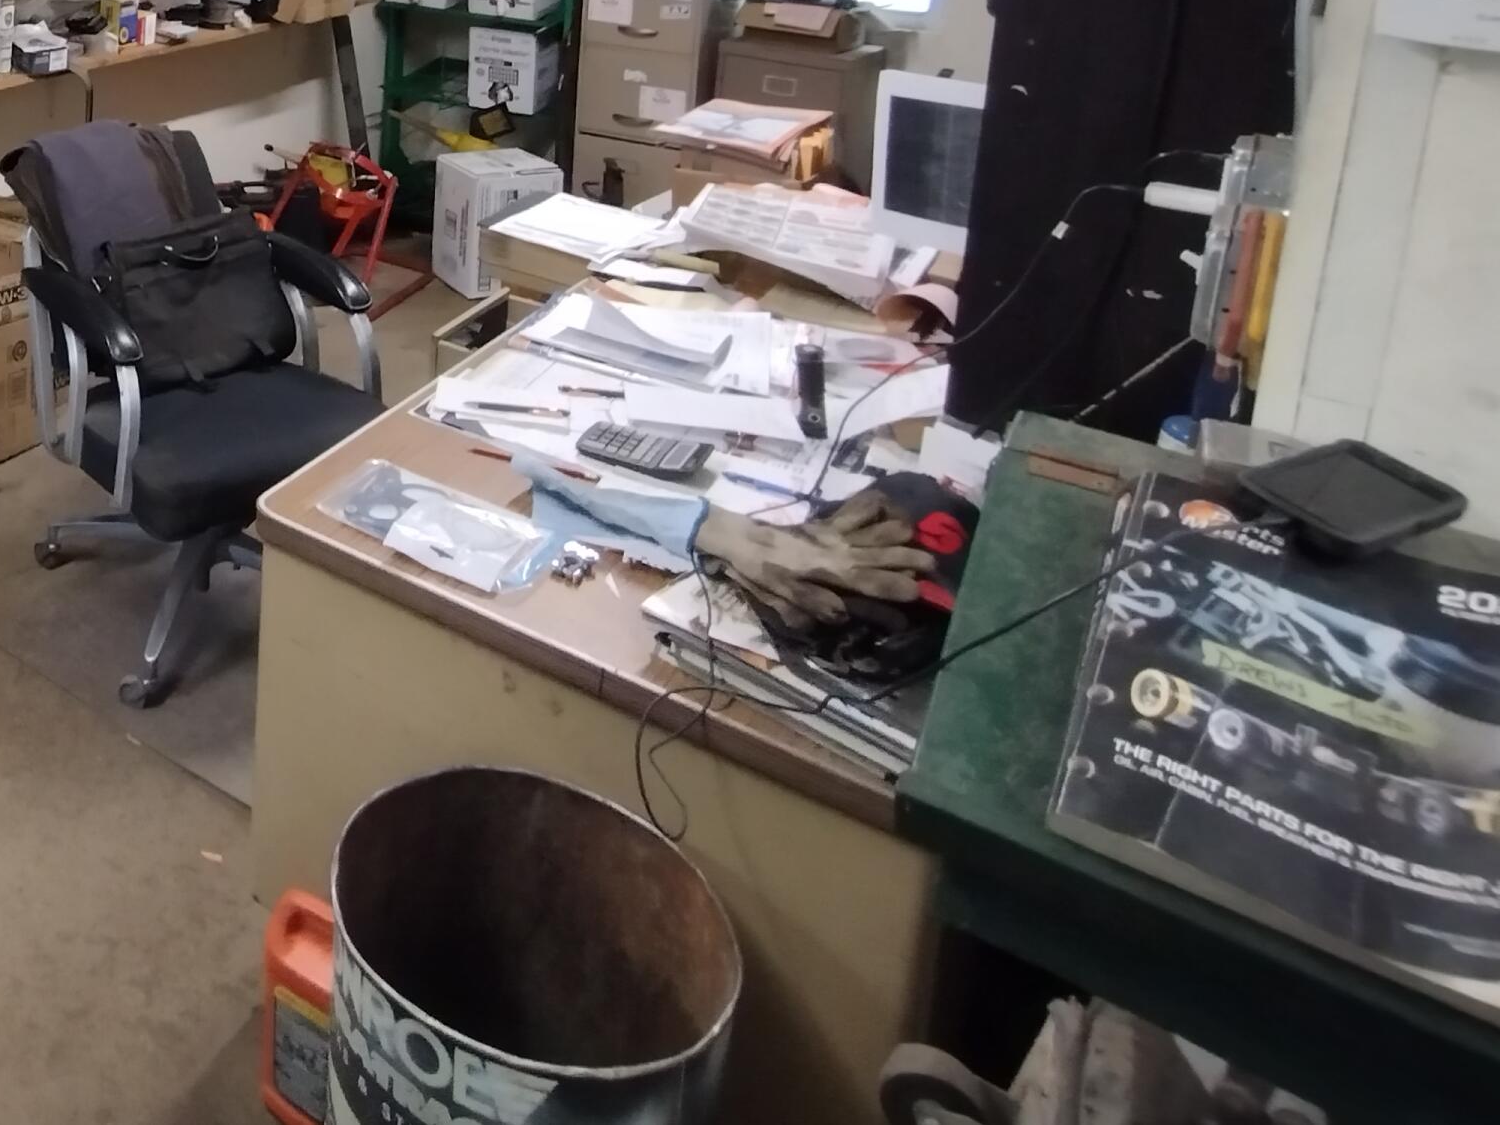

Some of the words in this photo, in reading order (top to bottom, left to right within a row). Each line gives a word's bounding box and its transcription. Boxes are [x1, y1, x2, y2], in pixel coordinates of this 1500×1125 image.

[1113, 736, 1153, 763] THE
[1156, 752, 1223, 793] RIGHT
[1224, 785, 1300, 832] PARTS
[1303, 821, 1354, 858] FOR
[1357, 843, 1407, 875] THE
[1409, 861, 1489, 894] RIGHT
